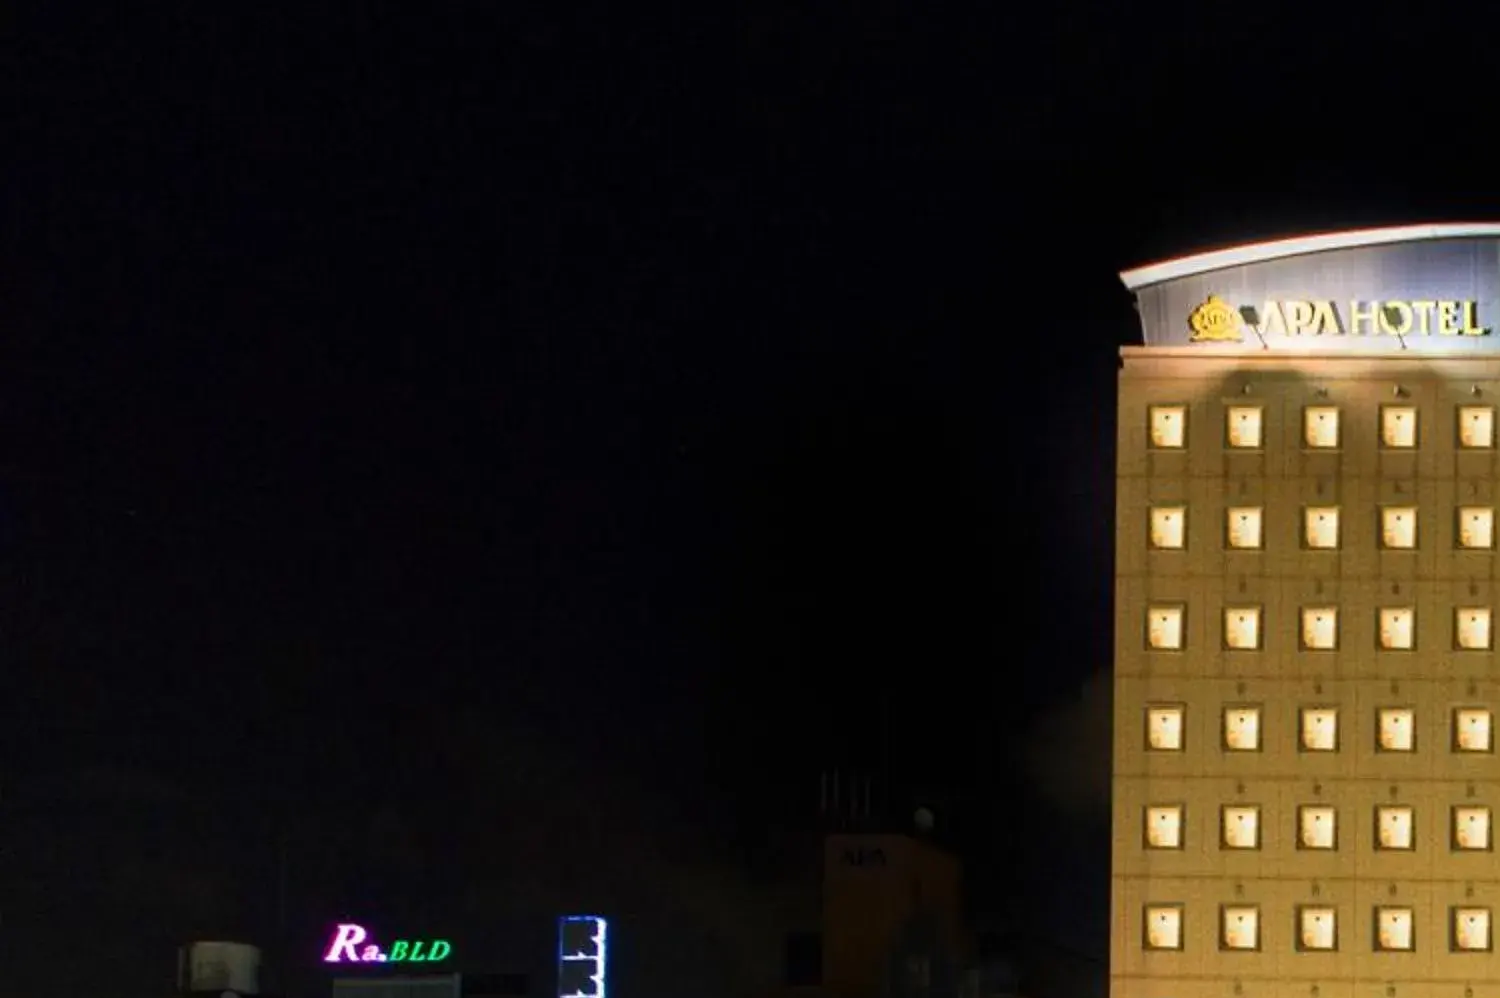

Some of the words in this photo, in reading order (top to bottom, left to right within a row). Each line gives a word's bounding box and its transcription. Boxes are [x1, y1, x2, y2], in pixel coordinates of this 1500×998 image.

[1257, 299, 1339, 336] APA
[1350, 299, 1487, 336] HOTEL
[389, 939, 451, 962] BLD
